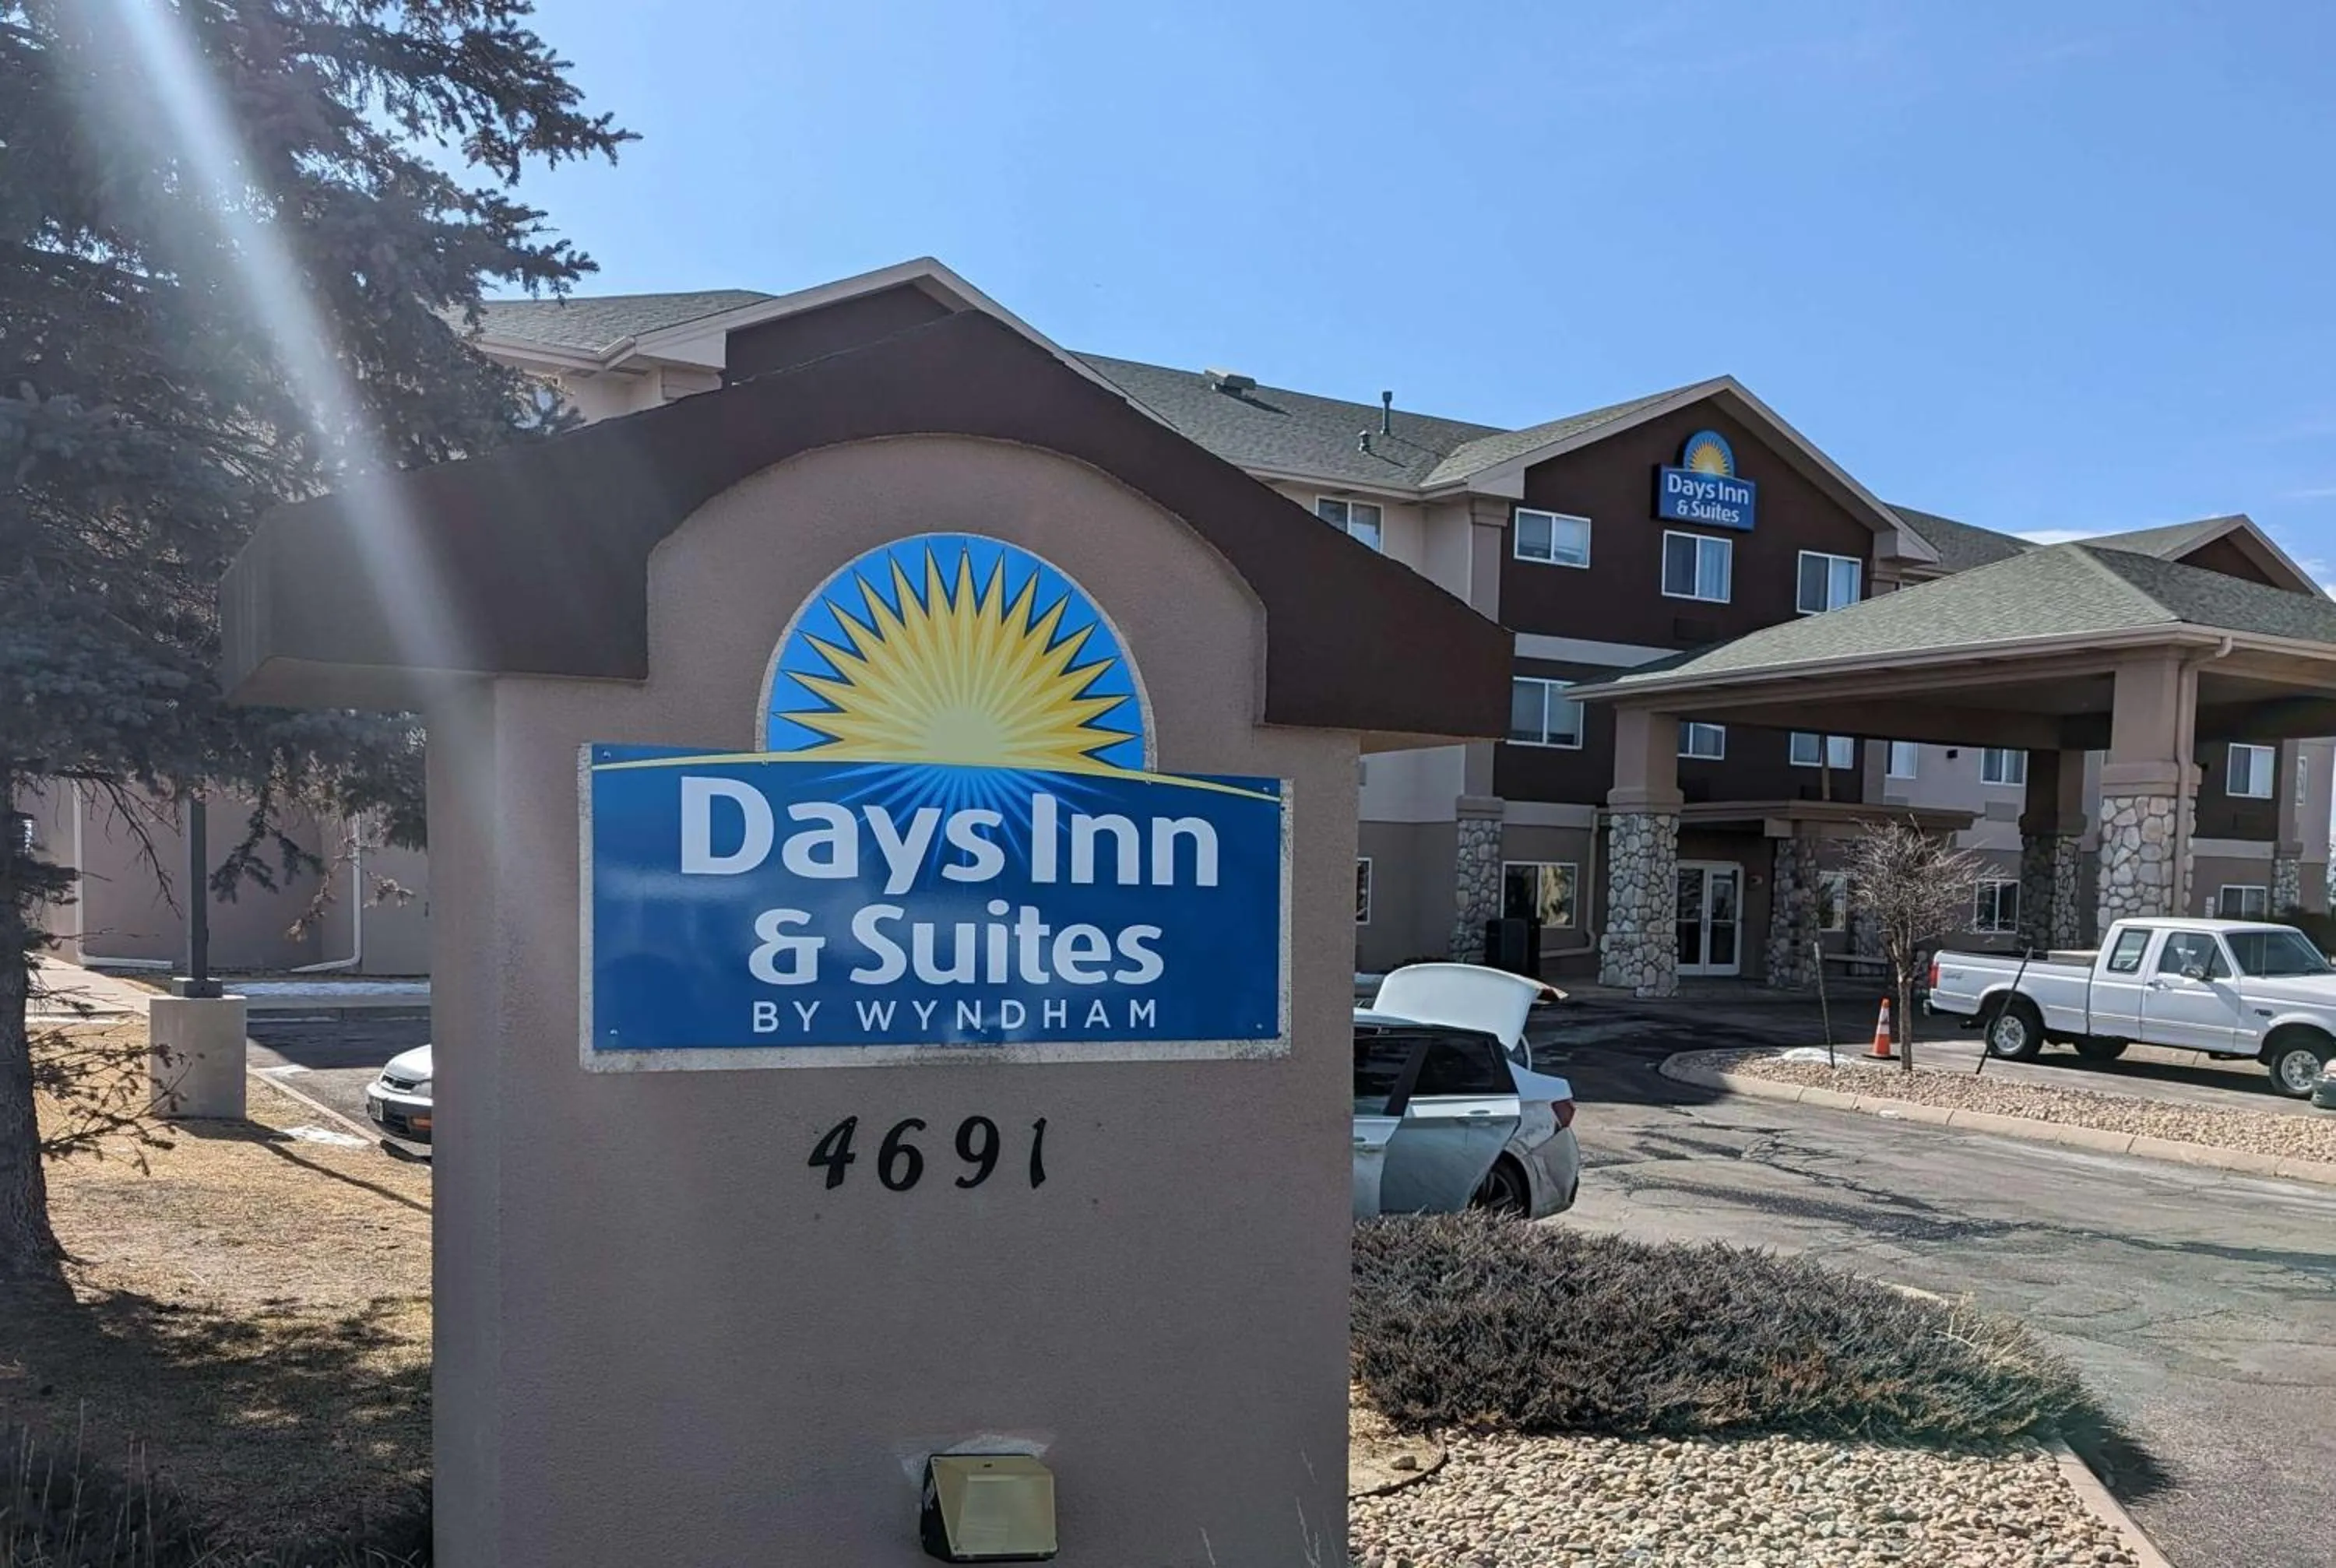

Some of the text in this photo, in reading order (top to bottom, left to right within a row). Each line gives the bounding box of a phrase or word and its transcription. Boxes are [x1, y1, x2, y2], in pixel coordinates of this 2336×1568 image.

[1667, 473, 1749, 505] Days Inn
[1676, 499, 1740, 522] & Suites
[680, 775, 1220, 895] Days Inn
[748, 898, 1165, 986] & Suites
[752, 998, 1157, 1034] BY WYNDHAM
[807, 1115, 1047, 1193] 4691
